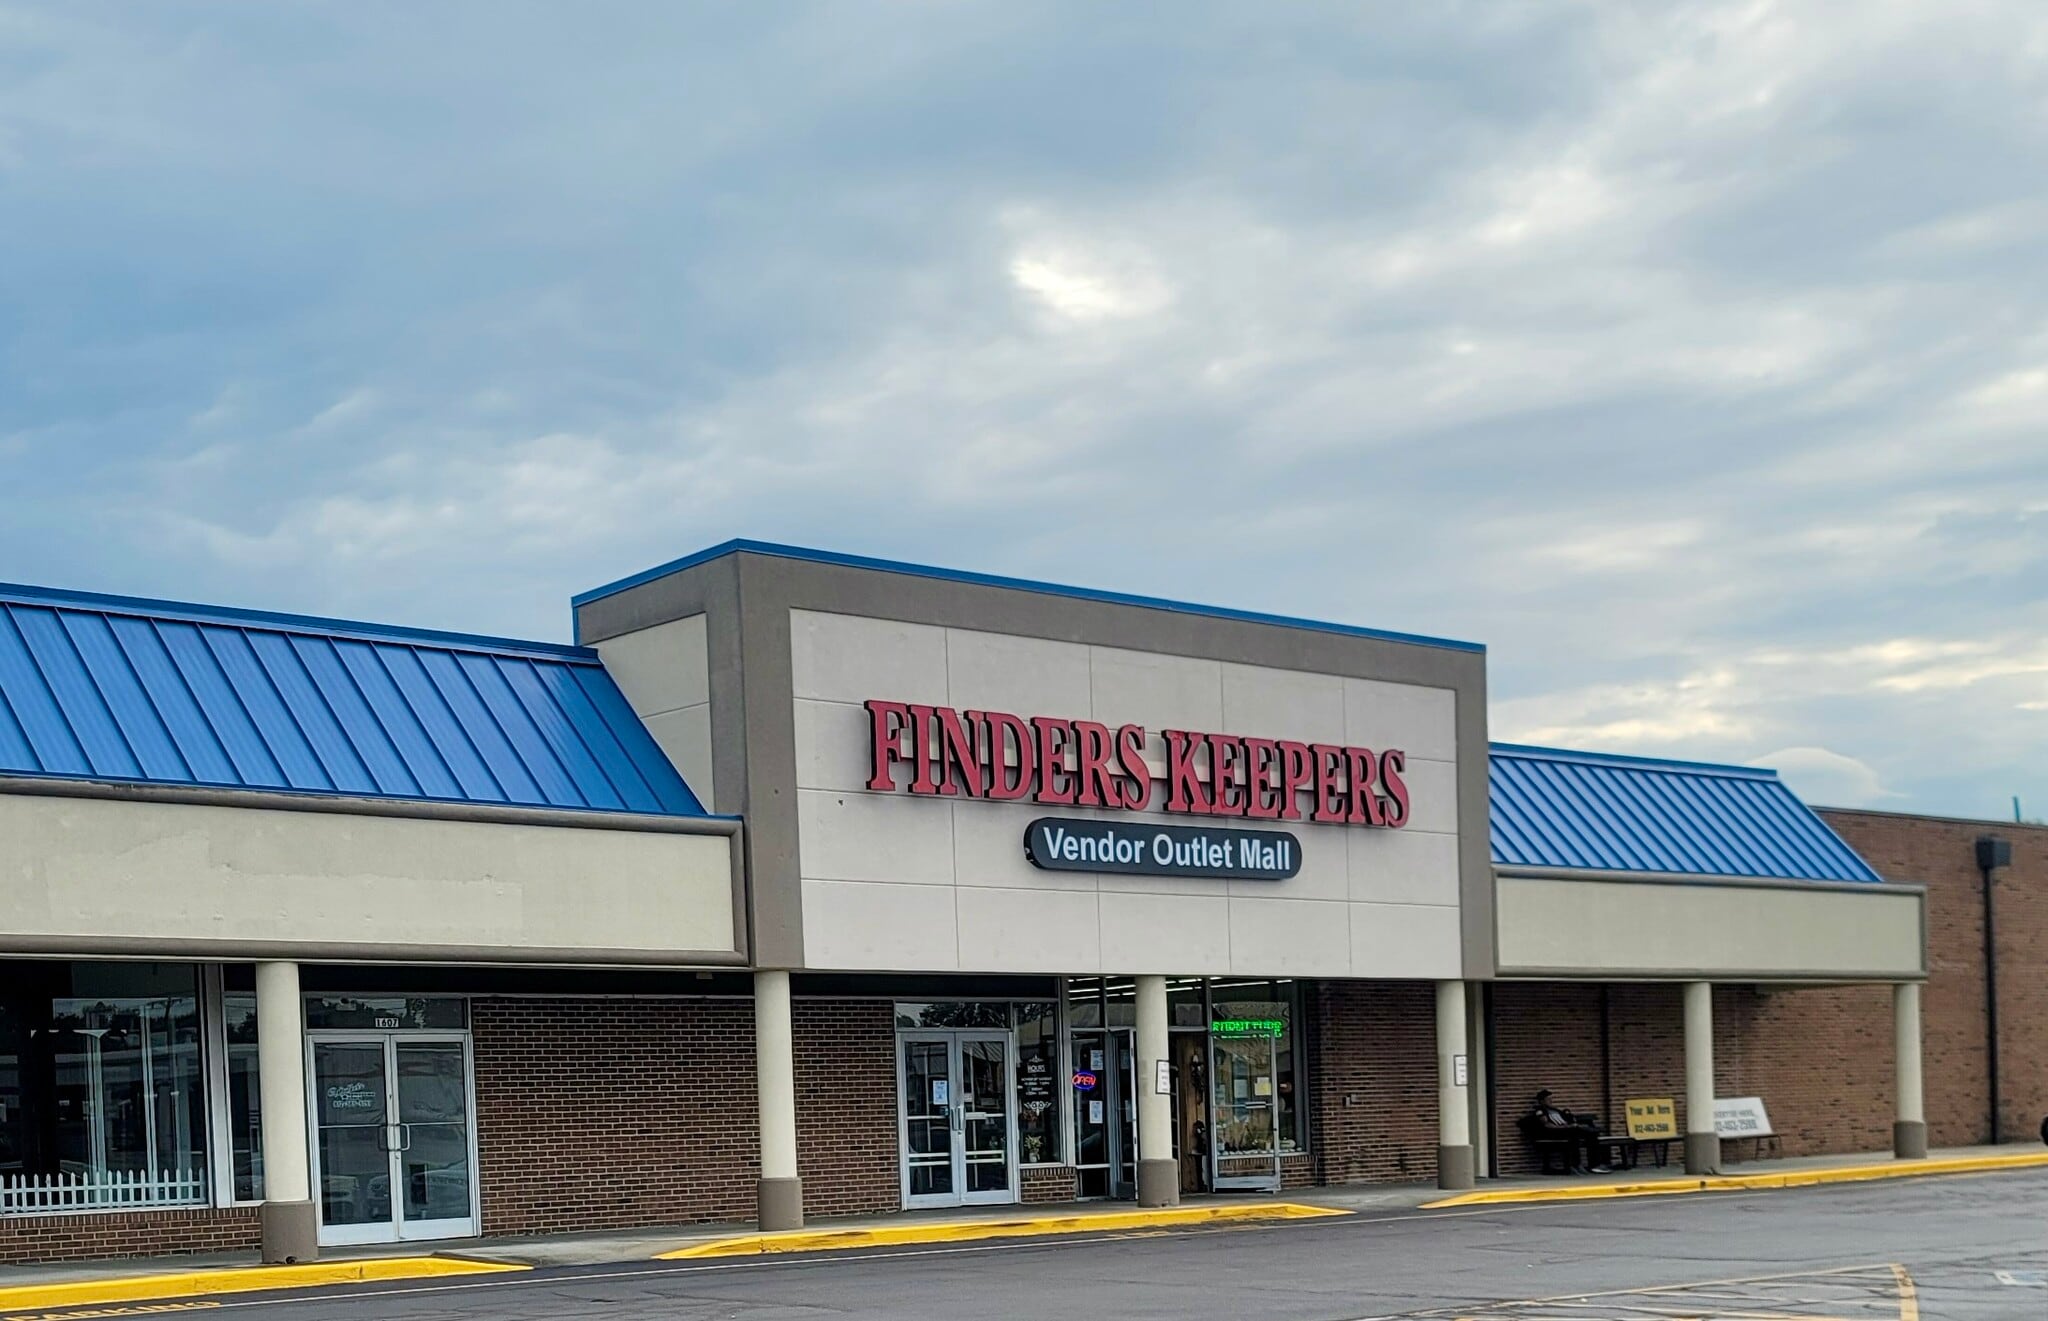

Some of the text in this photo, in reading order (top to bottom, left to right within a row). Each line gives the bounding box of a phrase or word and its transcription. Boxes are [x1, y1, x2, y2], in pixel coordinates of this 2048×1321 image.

[864, 700, 1409, 828] FINDERS KEEPERS
[1043, 827, 1291, 871] Vendor Outlet Mall
[376, 1018, 398, 1027] 1607
[1072, 1073, 1096, 1086] OPEN
[2, 1301, 221, 1321] PARKING
